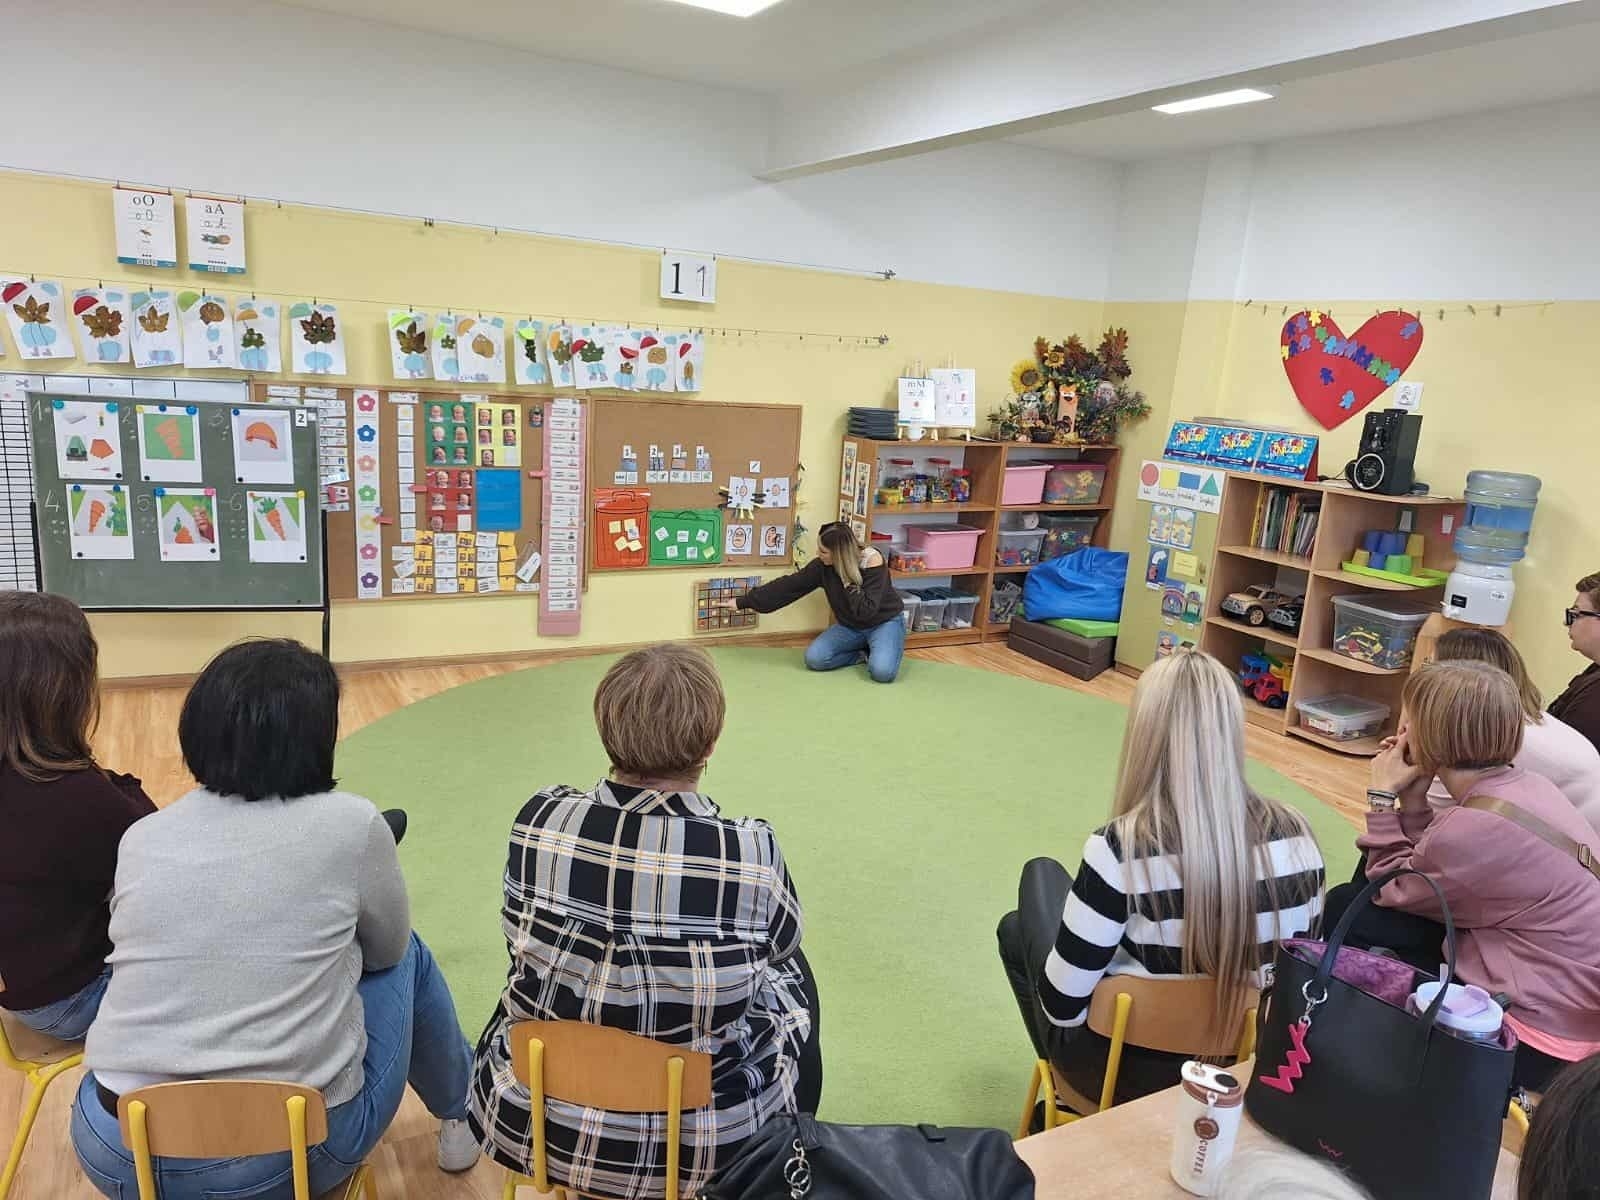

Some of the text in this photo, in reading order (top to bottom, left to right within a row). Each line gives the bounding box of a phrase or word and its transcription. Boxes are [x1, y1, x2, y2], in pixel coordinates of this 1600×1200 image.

[296, 413, 305, 424] 2
[44, 490, 60, 512] 4
[137, 494, 150, 512] 5
[1193, 1139, 1209, 1174] COFFEE
